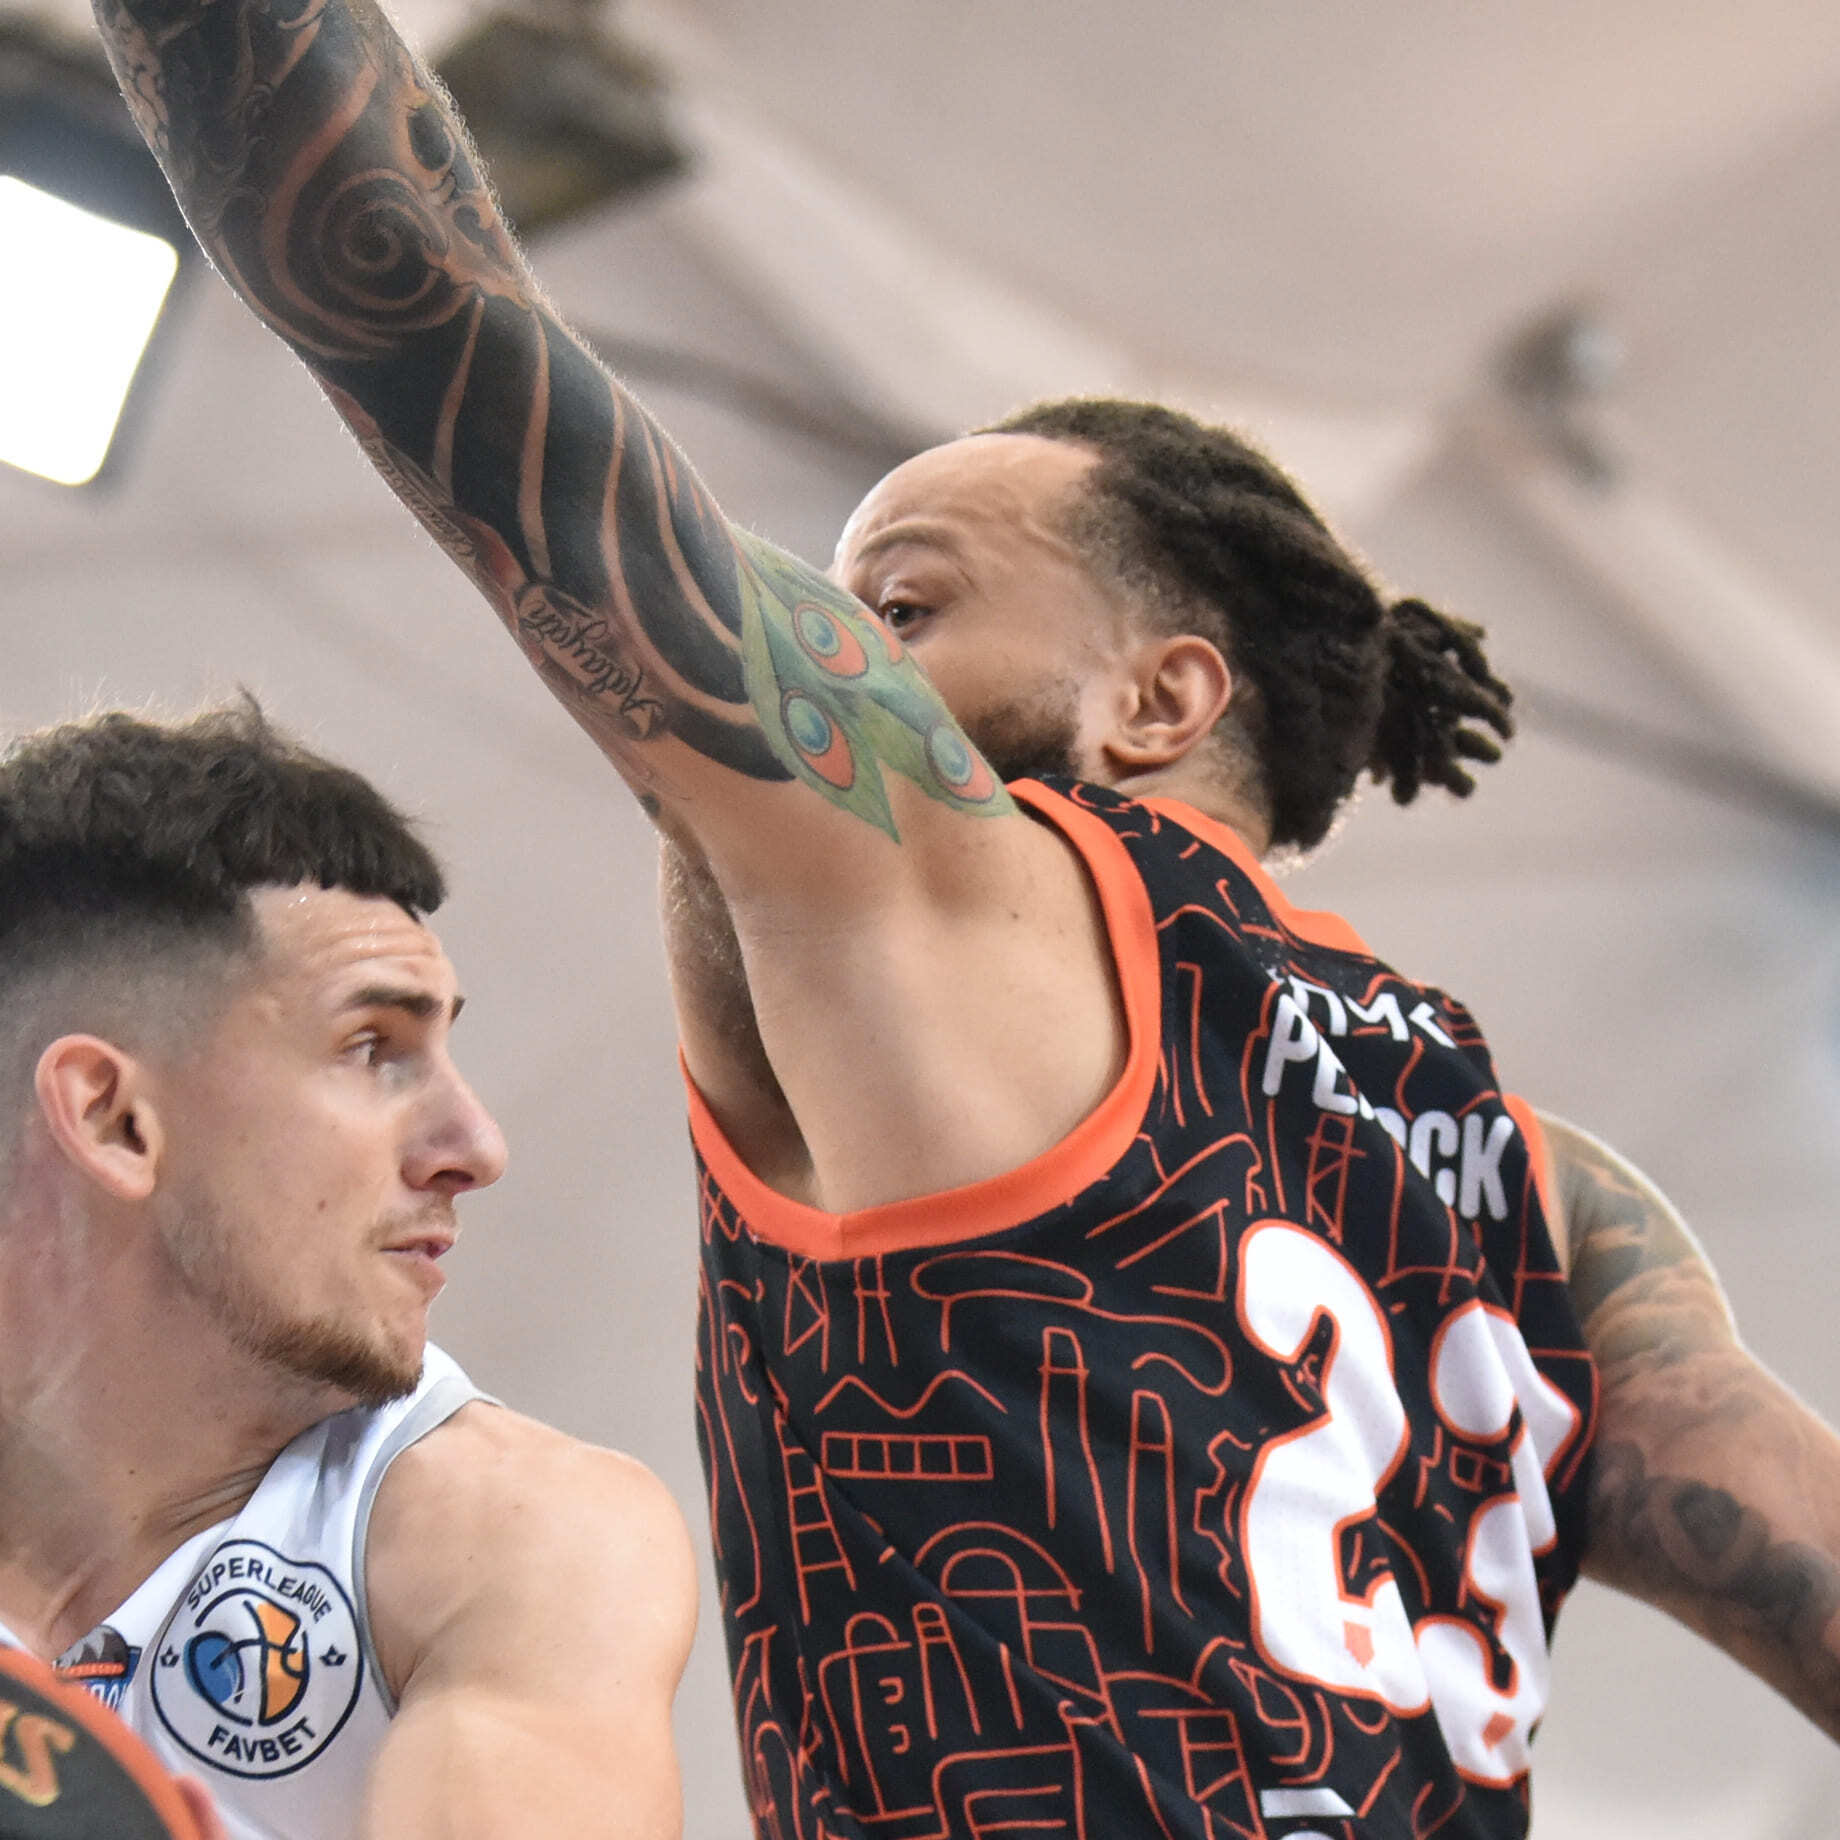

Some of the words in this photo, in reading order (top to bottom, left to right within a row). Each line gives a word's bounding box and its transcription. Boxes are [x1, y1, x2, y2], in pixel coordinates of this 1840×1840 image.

[1265, 966, 1460, 1050] ПМК
[1236, 1218, 1583, 1790] 23
[187, 1556, 332, 1624] SUPERLEAGUE
[207, 1717, 317, 1763] FAVBET
